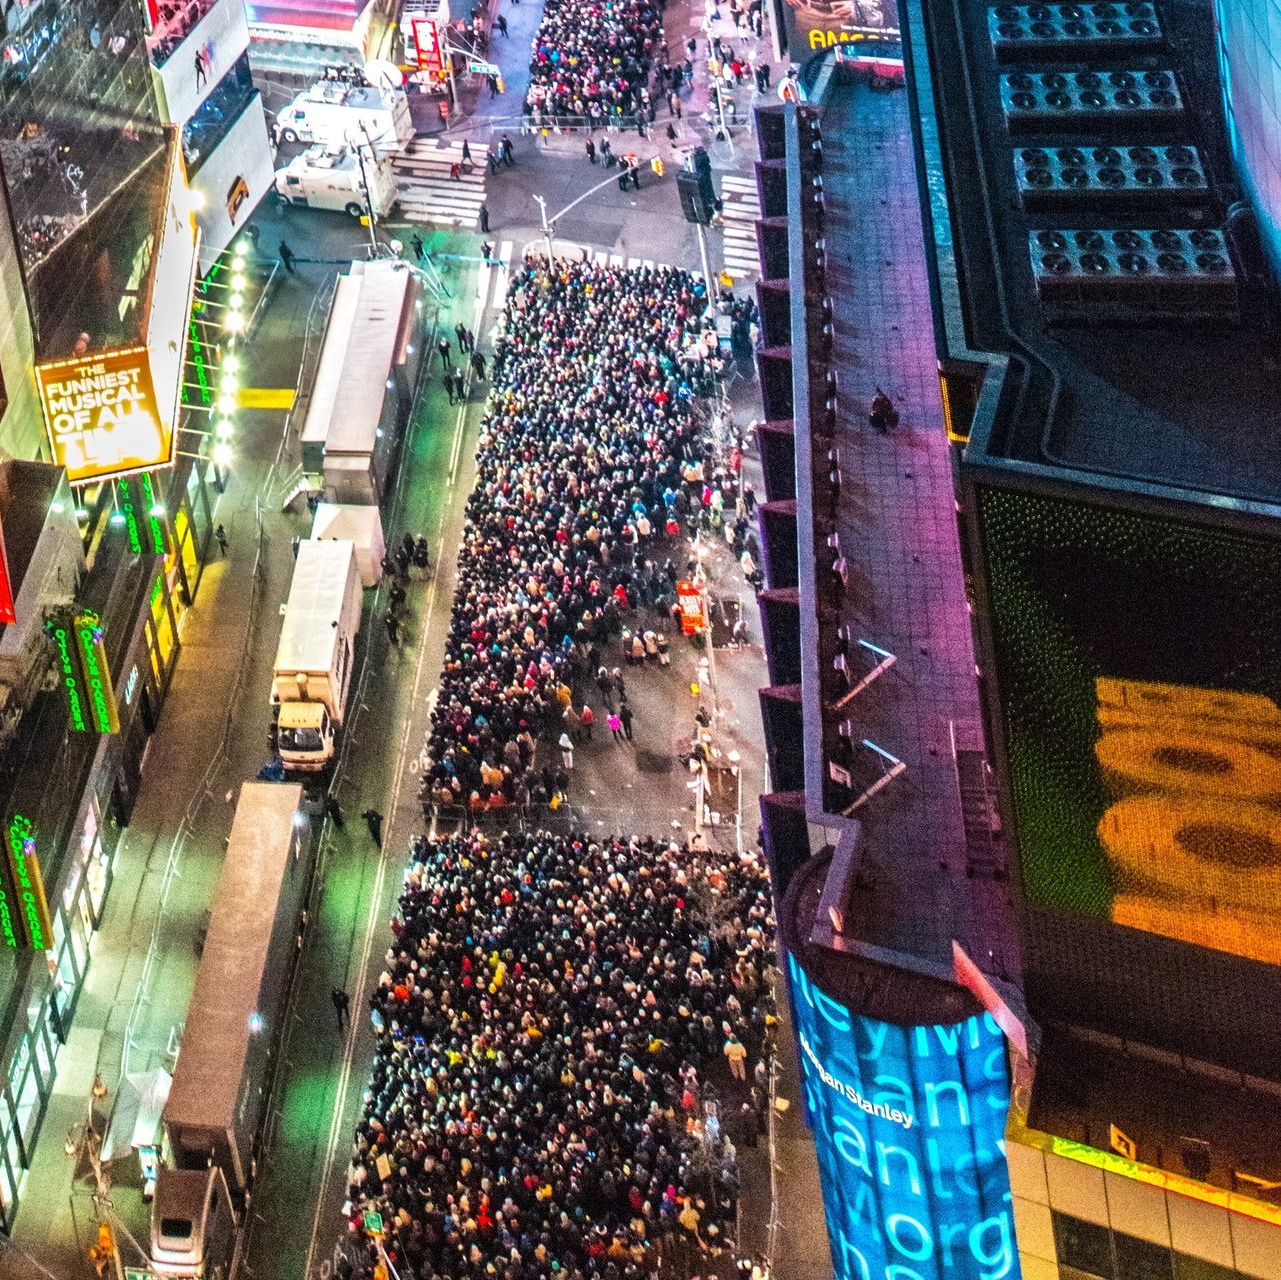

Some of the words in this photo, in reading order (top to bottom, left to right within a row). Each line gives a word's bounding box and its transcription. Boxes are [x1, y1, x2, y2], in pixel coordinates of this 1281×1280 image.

[46, 368, 141, 399] FUNNIEST
[75, 363, 106, 378] THE
[49, 384, 146, 416] MUSICAL
[53, 410, 91, 434] OF
[81, 629, 99, 676] OLIVE
[91, 679, 111, 733] GARDEN
[11, 840, 32, 889] OLIVE
[22, 892, 45, 951] GARDEN
[844, 1083, 914, 1130] Stanley
